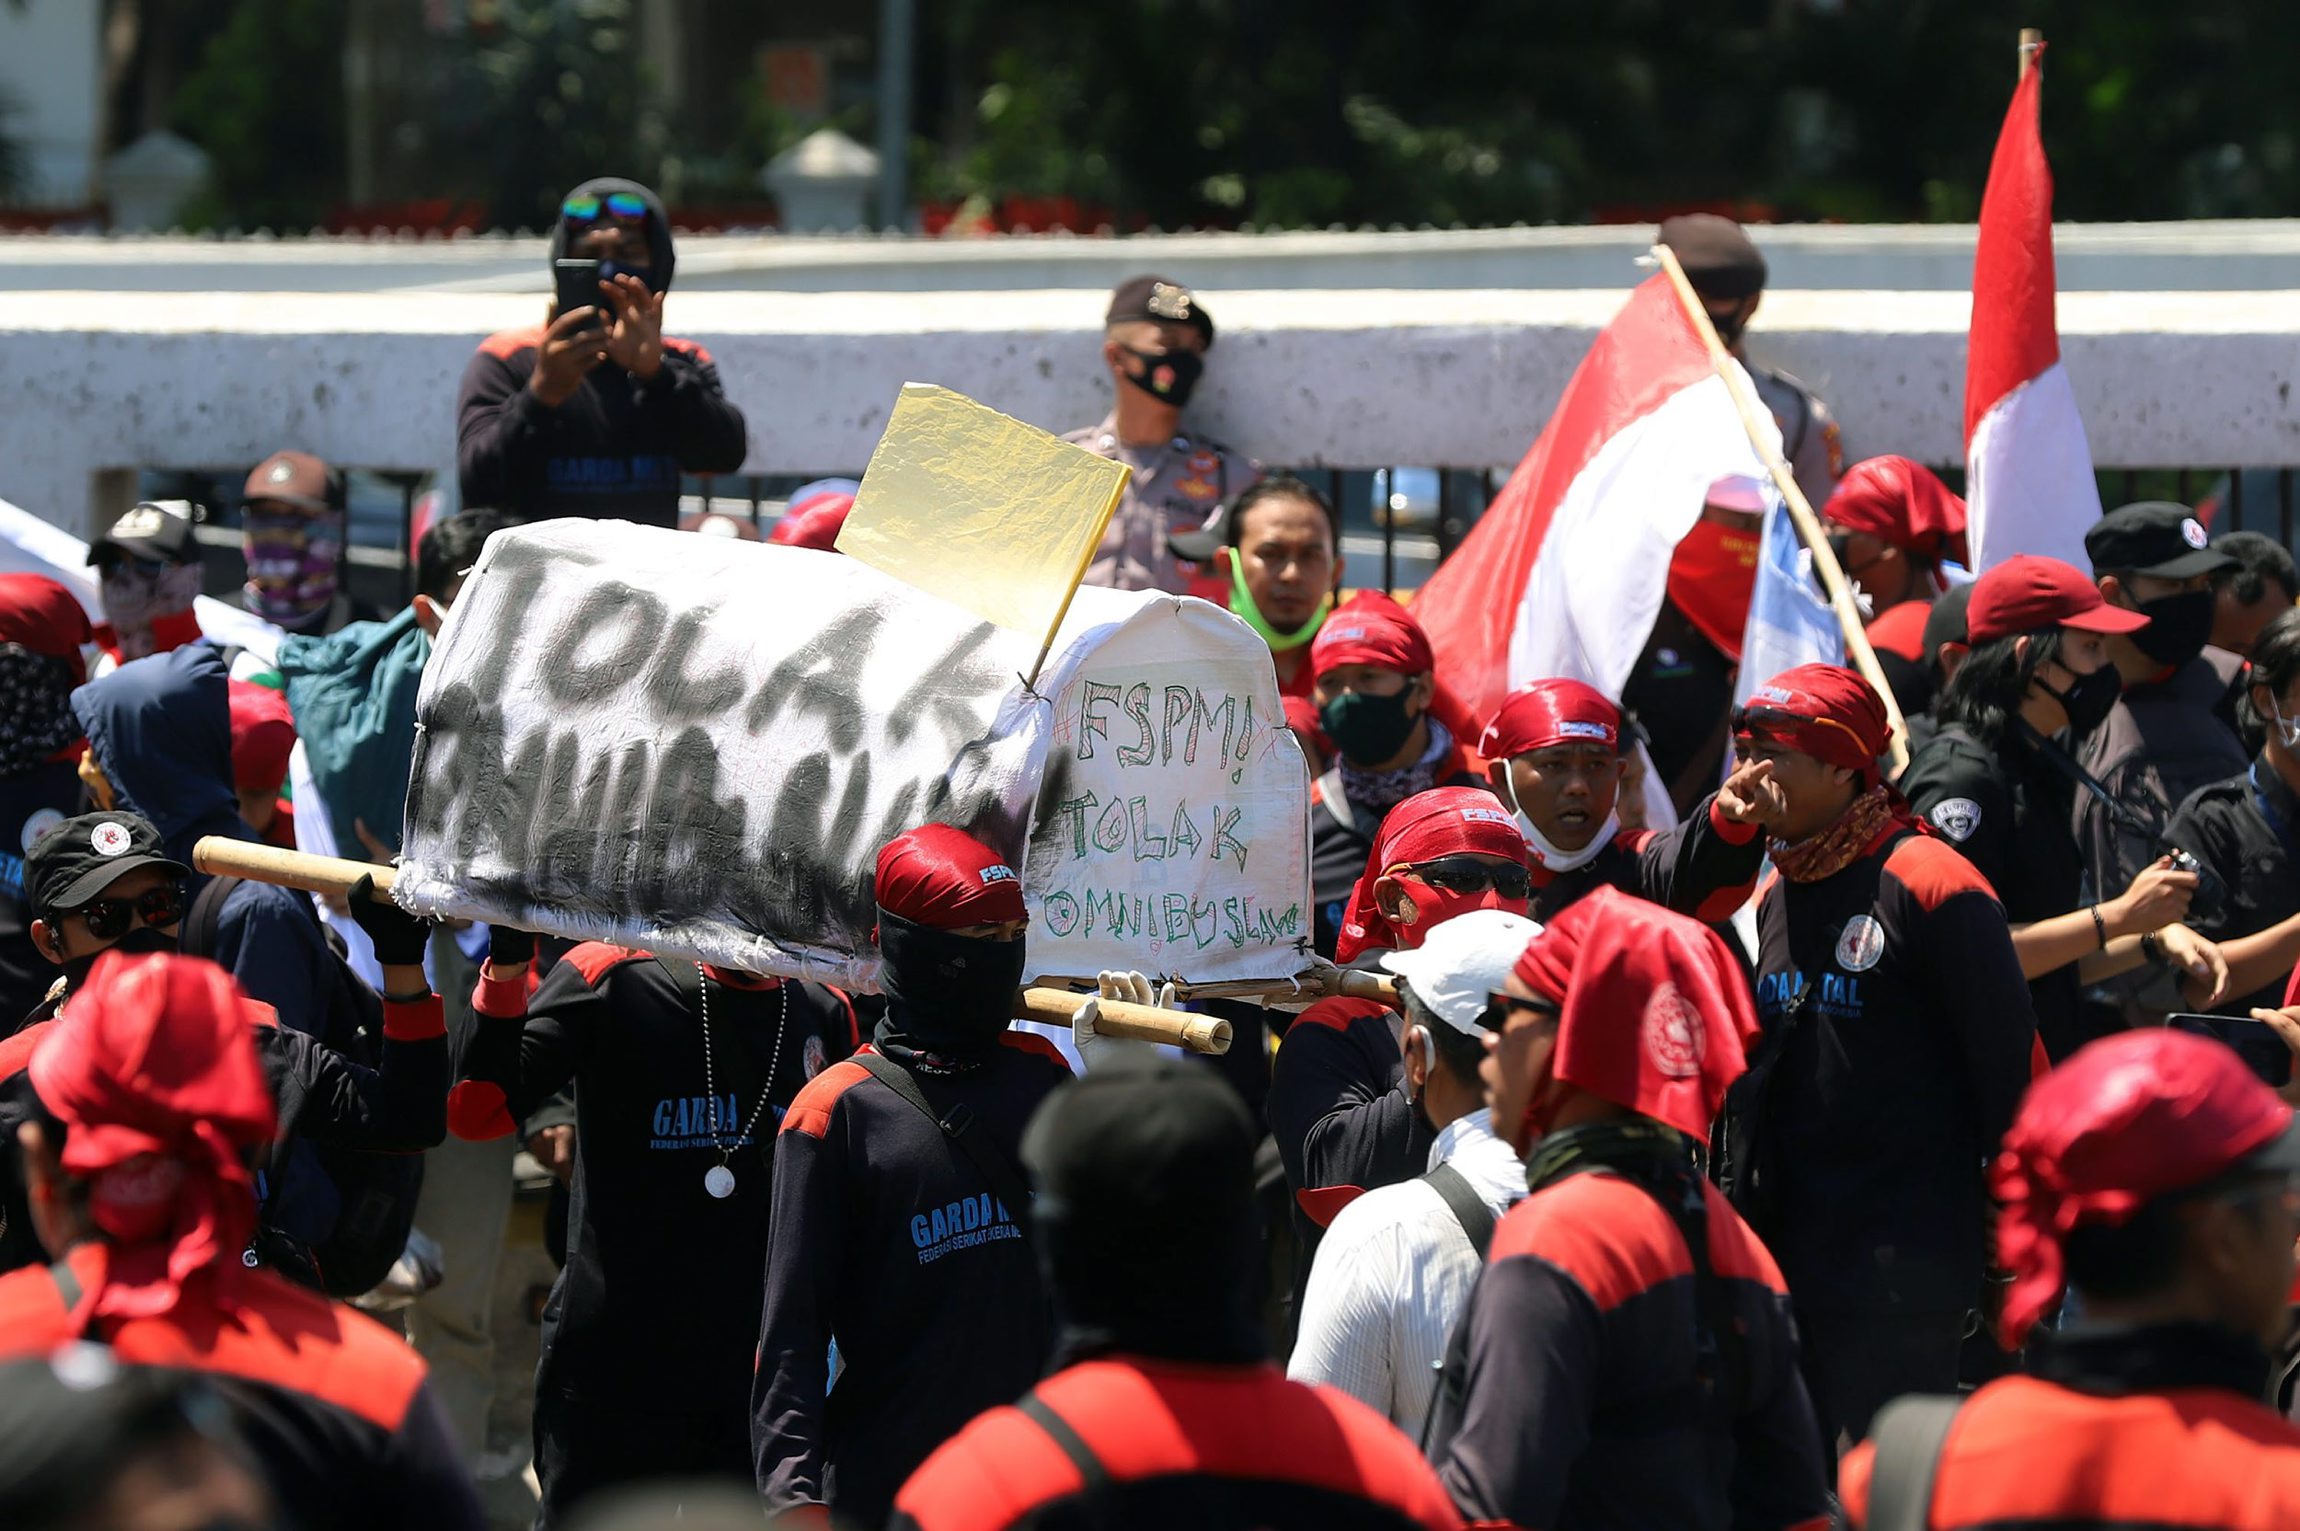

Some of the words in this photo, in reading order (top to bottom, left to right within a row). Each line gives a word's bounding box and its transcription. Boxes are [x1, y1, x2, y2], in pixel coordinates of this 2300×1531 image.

[478, 532, 1010, 758] TOLAK
[1060, 789, 1248, 873] TOLAK
[652, 1092, 738, 1137] GARDA
[910, 1192, 993, 1248] GARDA
[952, 1229, 988, 1251] SERIKAT
